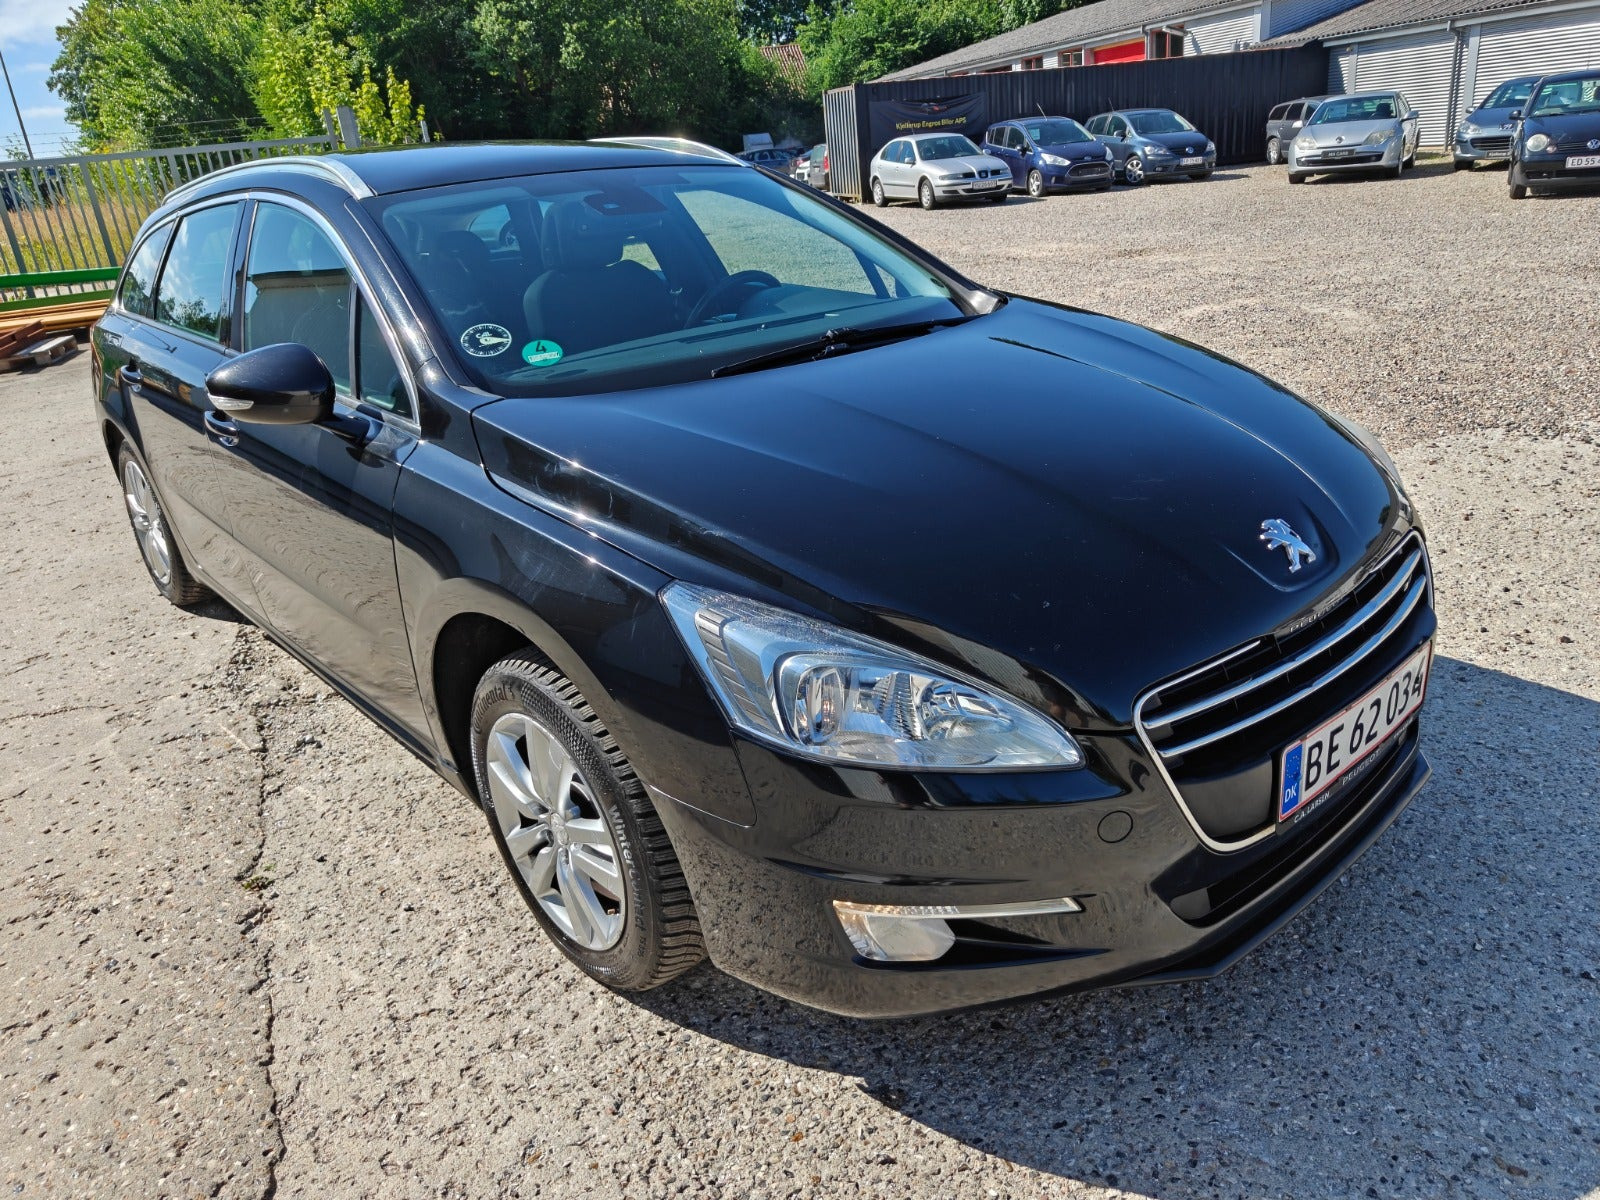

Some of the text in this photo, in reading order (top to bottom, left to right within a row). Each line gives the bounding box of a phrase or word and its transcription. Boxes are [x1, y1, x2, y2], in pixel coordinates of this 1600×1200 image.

[922, 120, 941, 128] Engros
[1585, 157, 1596, 165] 55
[535, 341, 547, 352] 4
[474, 683, 509, 735] Continental
[1305, 655, 1426, 791] BE 62 034
[1307, 791, 1331, 813] LARSEN
[1342, 749, 1384, 786] PEUGEOT
[1284, 783, 1298, 803] DK
